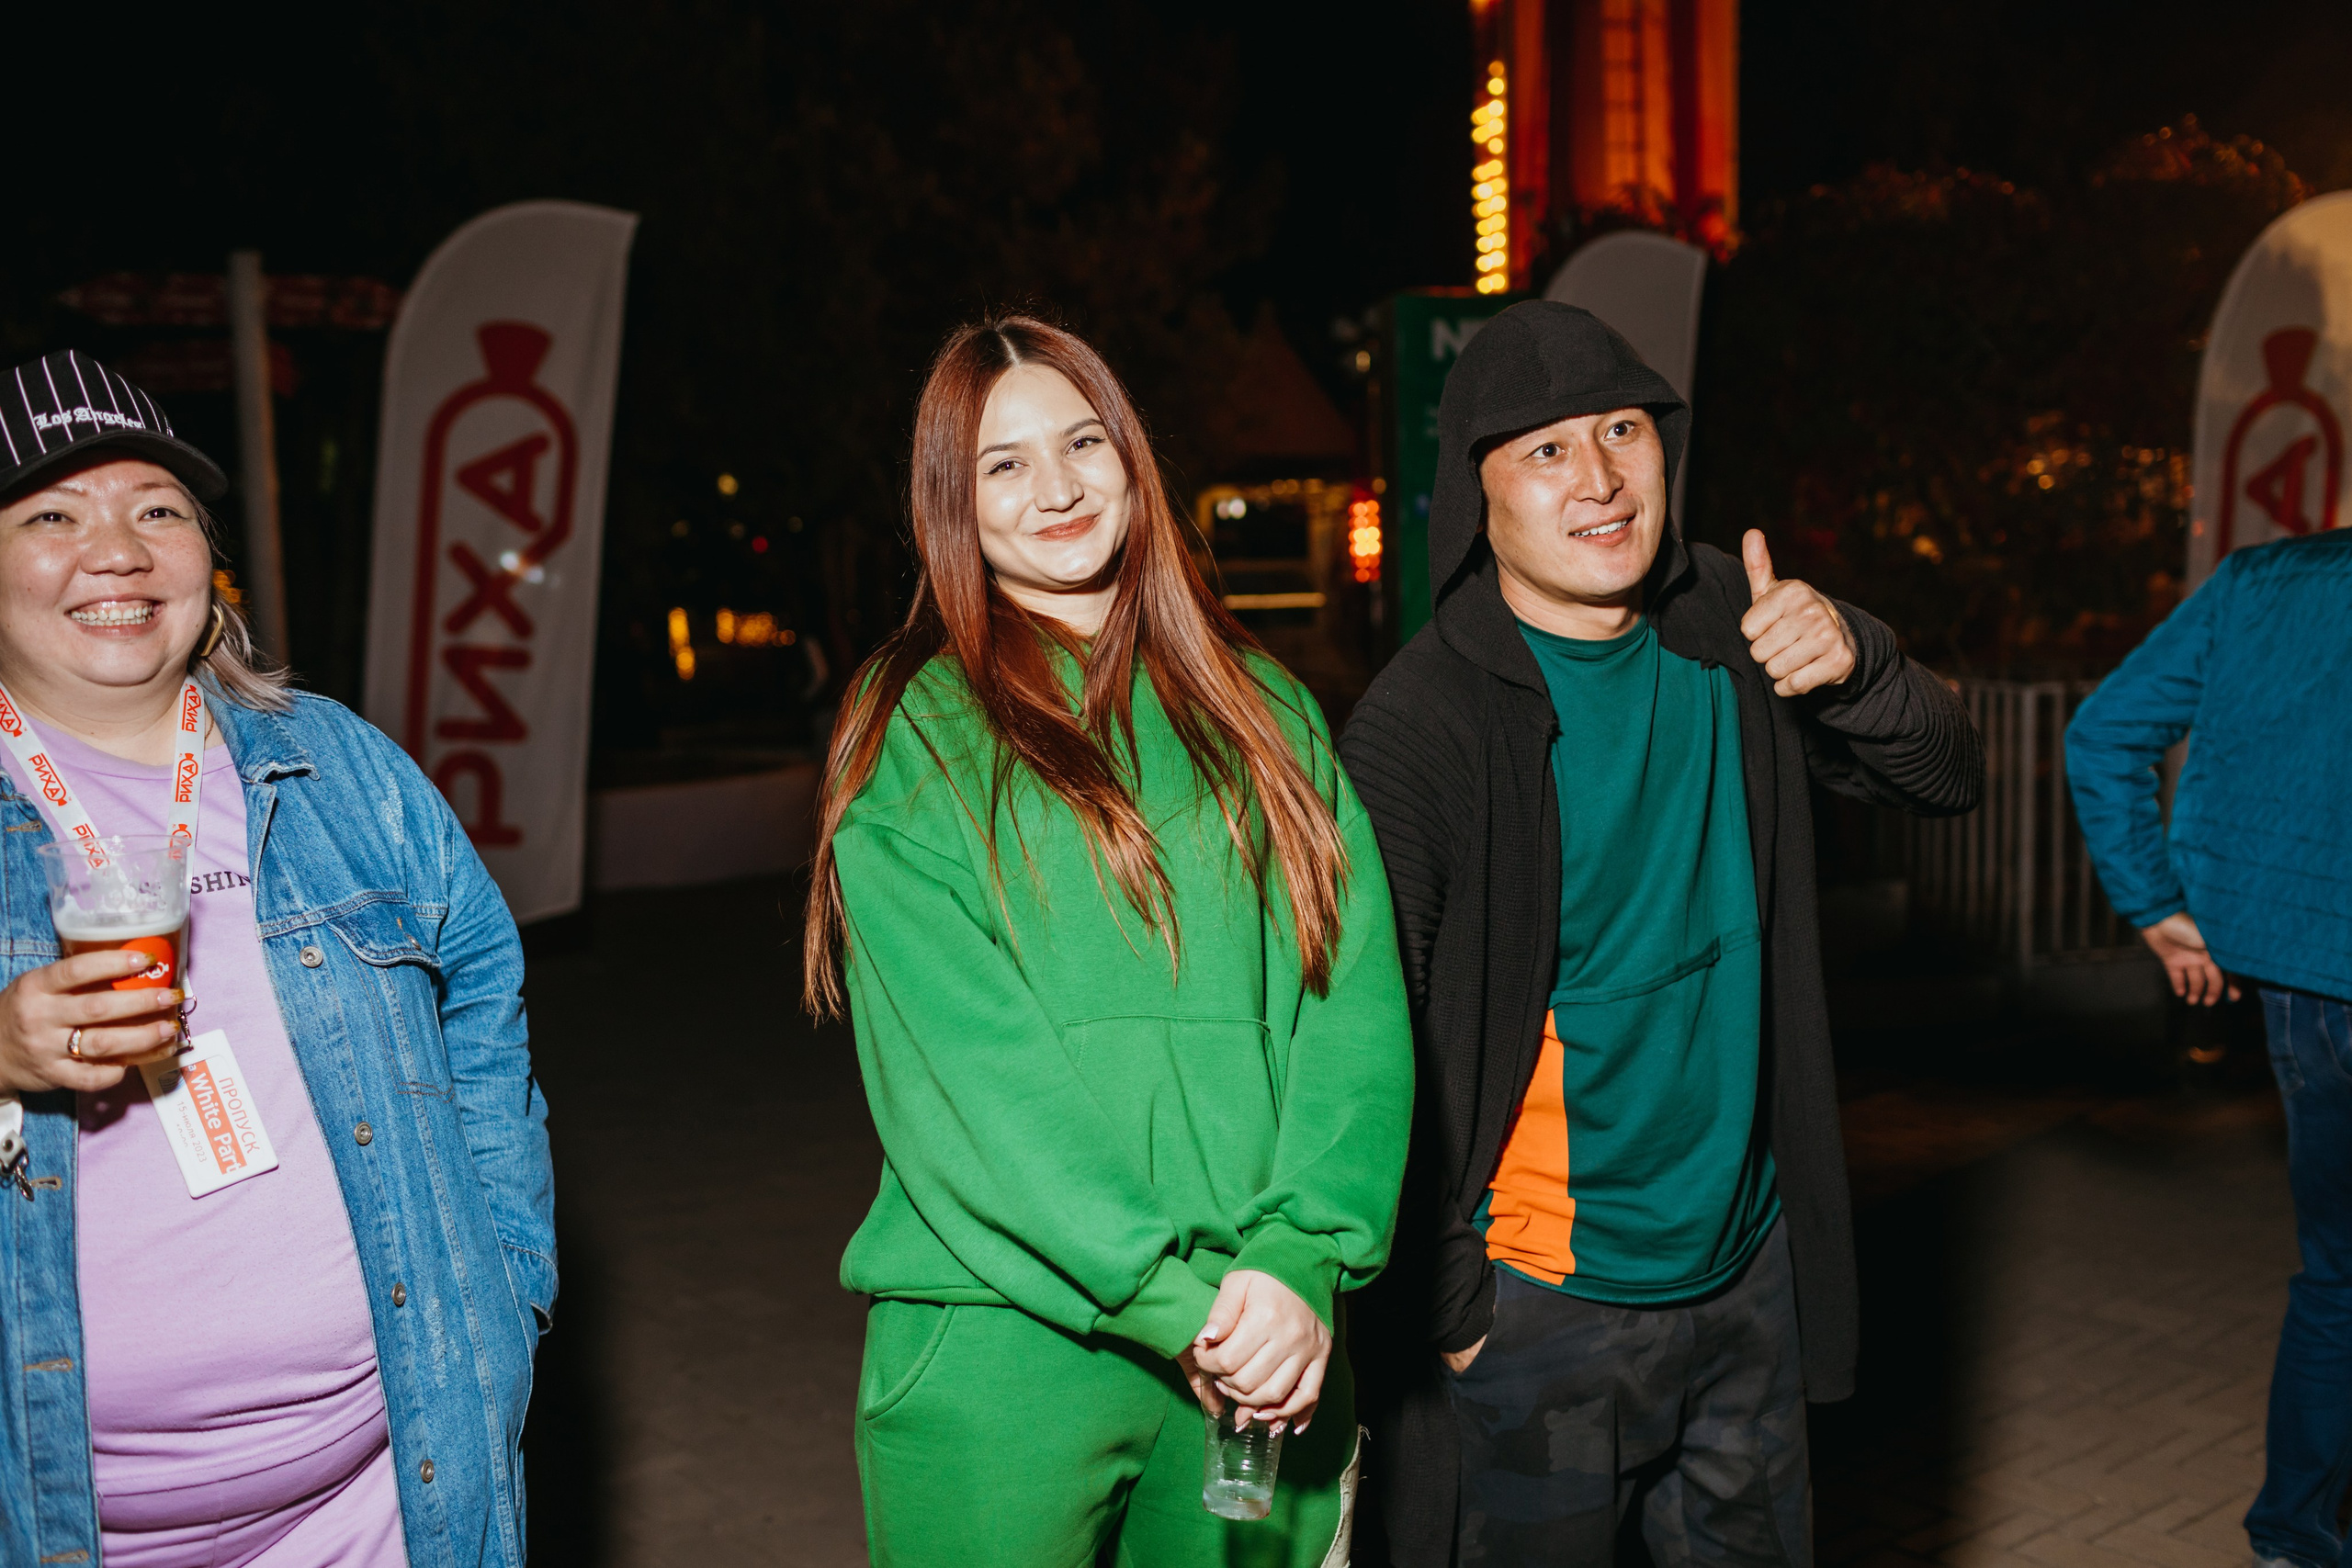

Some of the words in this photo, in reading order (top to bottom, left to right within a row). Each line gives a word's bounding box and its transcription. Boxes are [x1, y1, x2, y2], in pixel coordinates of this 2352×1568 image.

[33, 409, 73, 431] Los
[433, 429, 554, 850] РИХА
[185, 694, 199, 733] РИХА
[28, 754, 62, 799] РИХА
[178, 762, 197, 803] РИХА
[190, 1073, 222, 1130] White
[219, 1077, 260, 1154] ПРОПУСК
[177, 1101, 196, 1140] 15-июля
[192, 1140, 208, 1163] 2023
